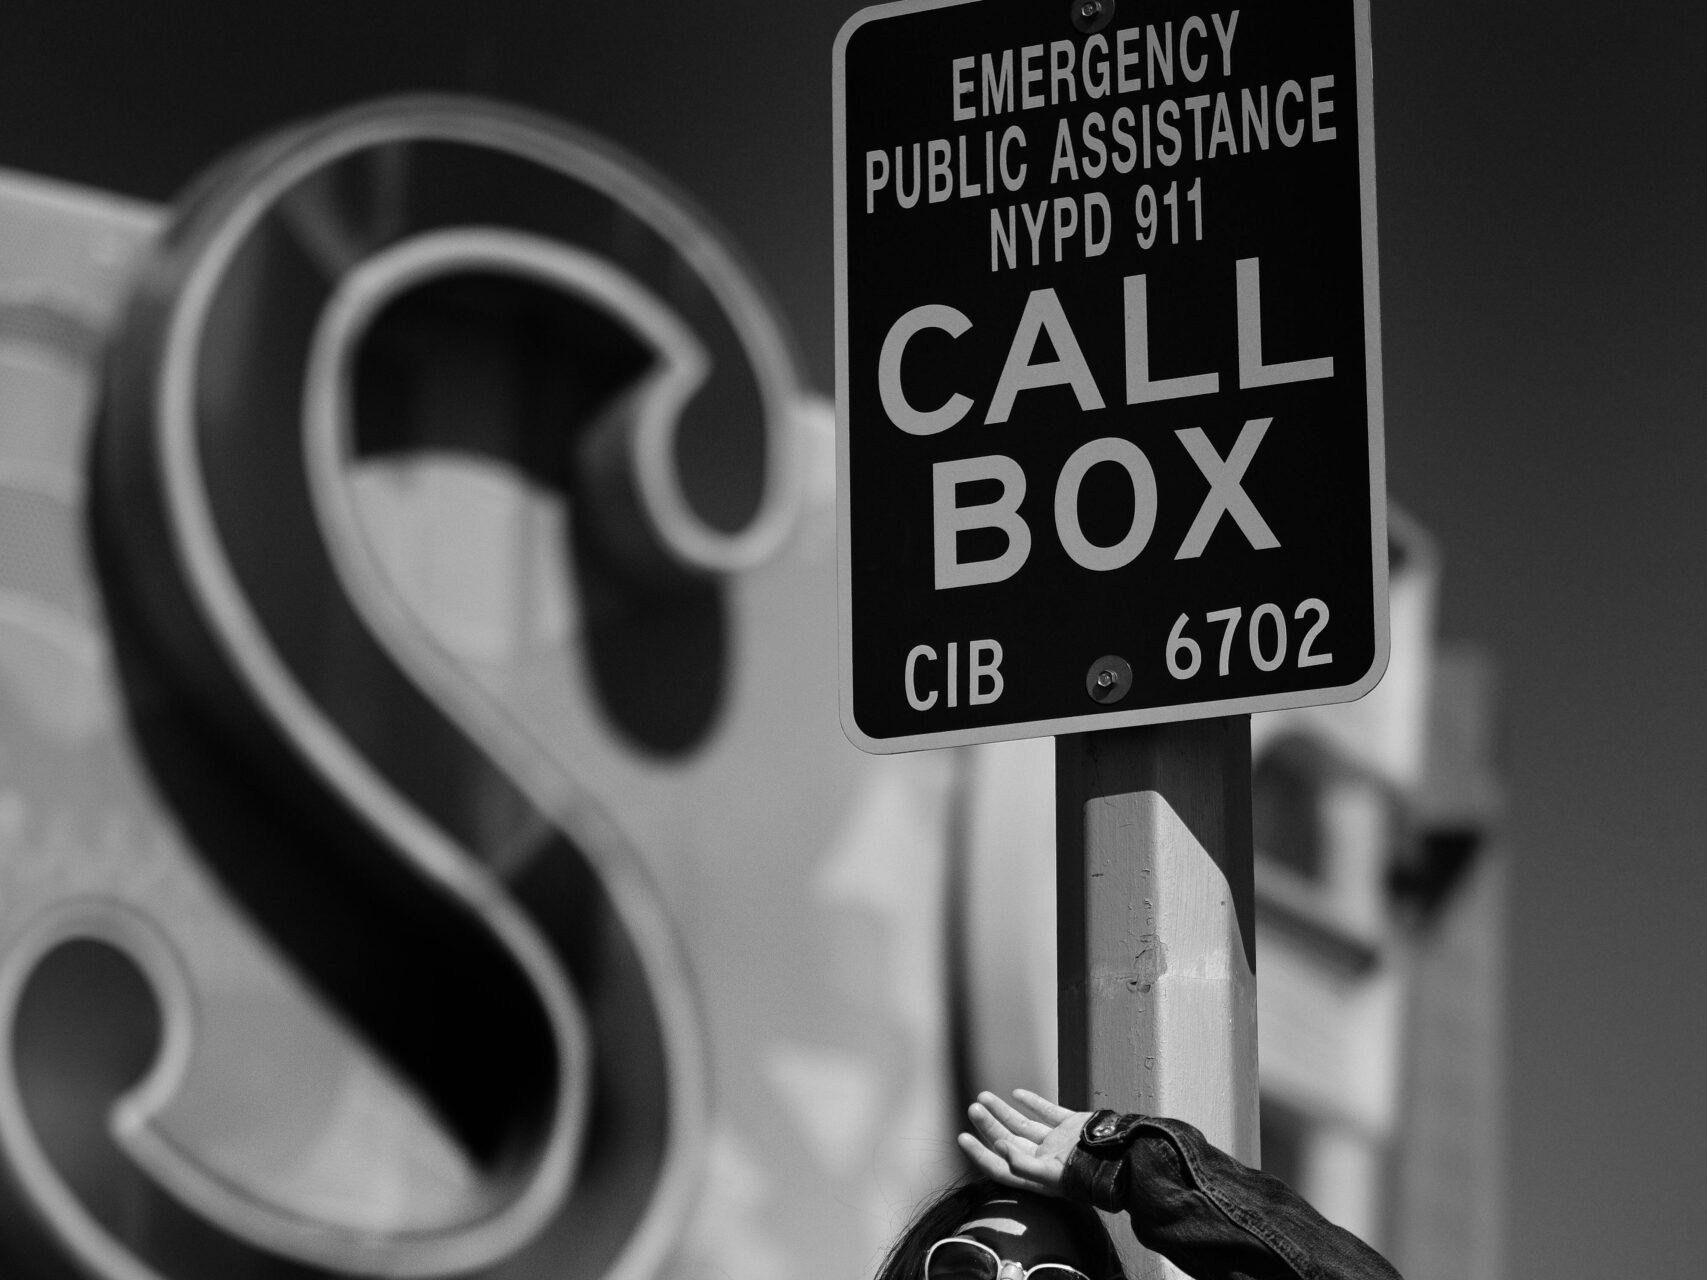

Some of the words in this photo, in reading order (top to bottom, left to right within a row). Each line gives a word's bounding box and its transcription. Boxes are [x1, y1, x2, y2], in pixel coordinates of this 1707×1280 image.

[951, 10, 1240, 122] EMERGENCY
[865, 125, 1028, 214] PUBLIC
[1050, 74, 1338, 184] ASSISTANCE
[989, 200, 1113, 272] NYPD
[1135, 177, 1204, 251] 911
[877, 257, 1335, 436] CALL
[932, 417, 1283, 592] BOX
[904, 638, 1005, 712] CIB
[1164, 597, 1334, 681] 6702
